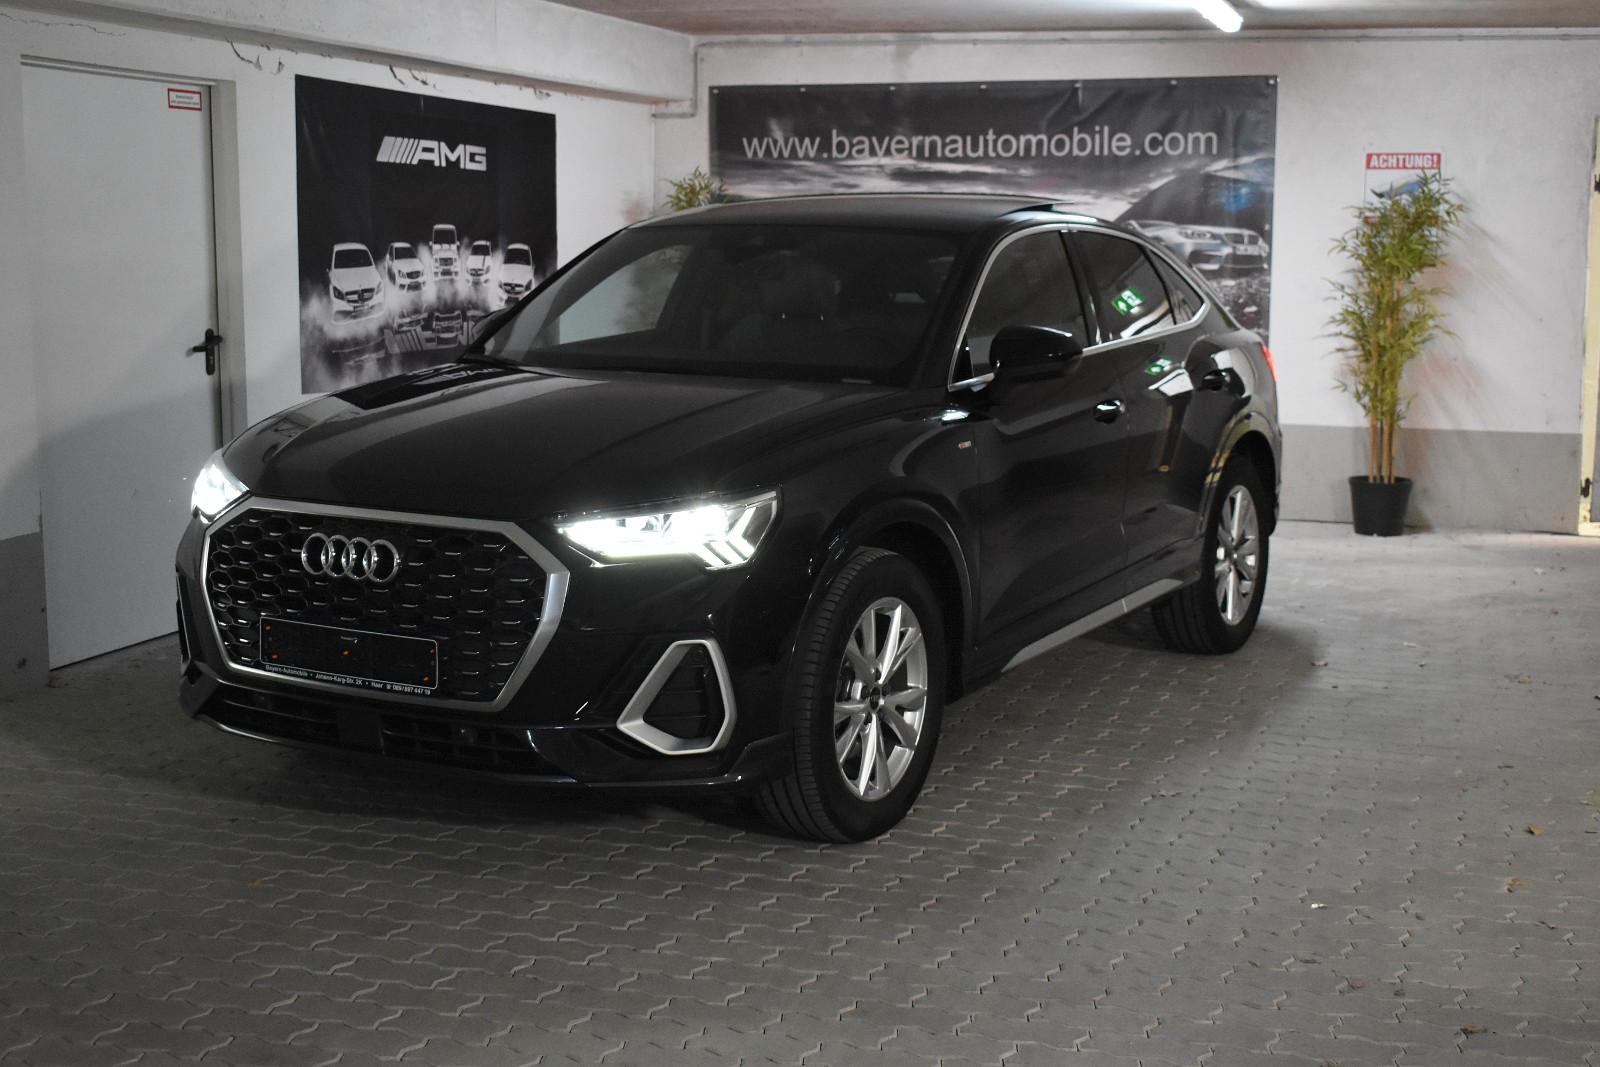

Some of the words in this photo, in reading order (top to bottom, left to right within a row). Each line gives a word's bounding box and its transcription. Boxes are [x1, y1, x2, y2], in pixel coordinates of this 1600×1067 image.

[410, 139, 487, 171] AMG
[743, 126, 1218, 163] www.bayernautomobile.com
[1370, 154, 1438, 168] ACHTUNG!
